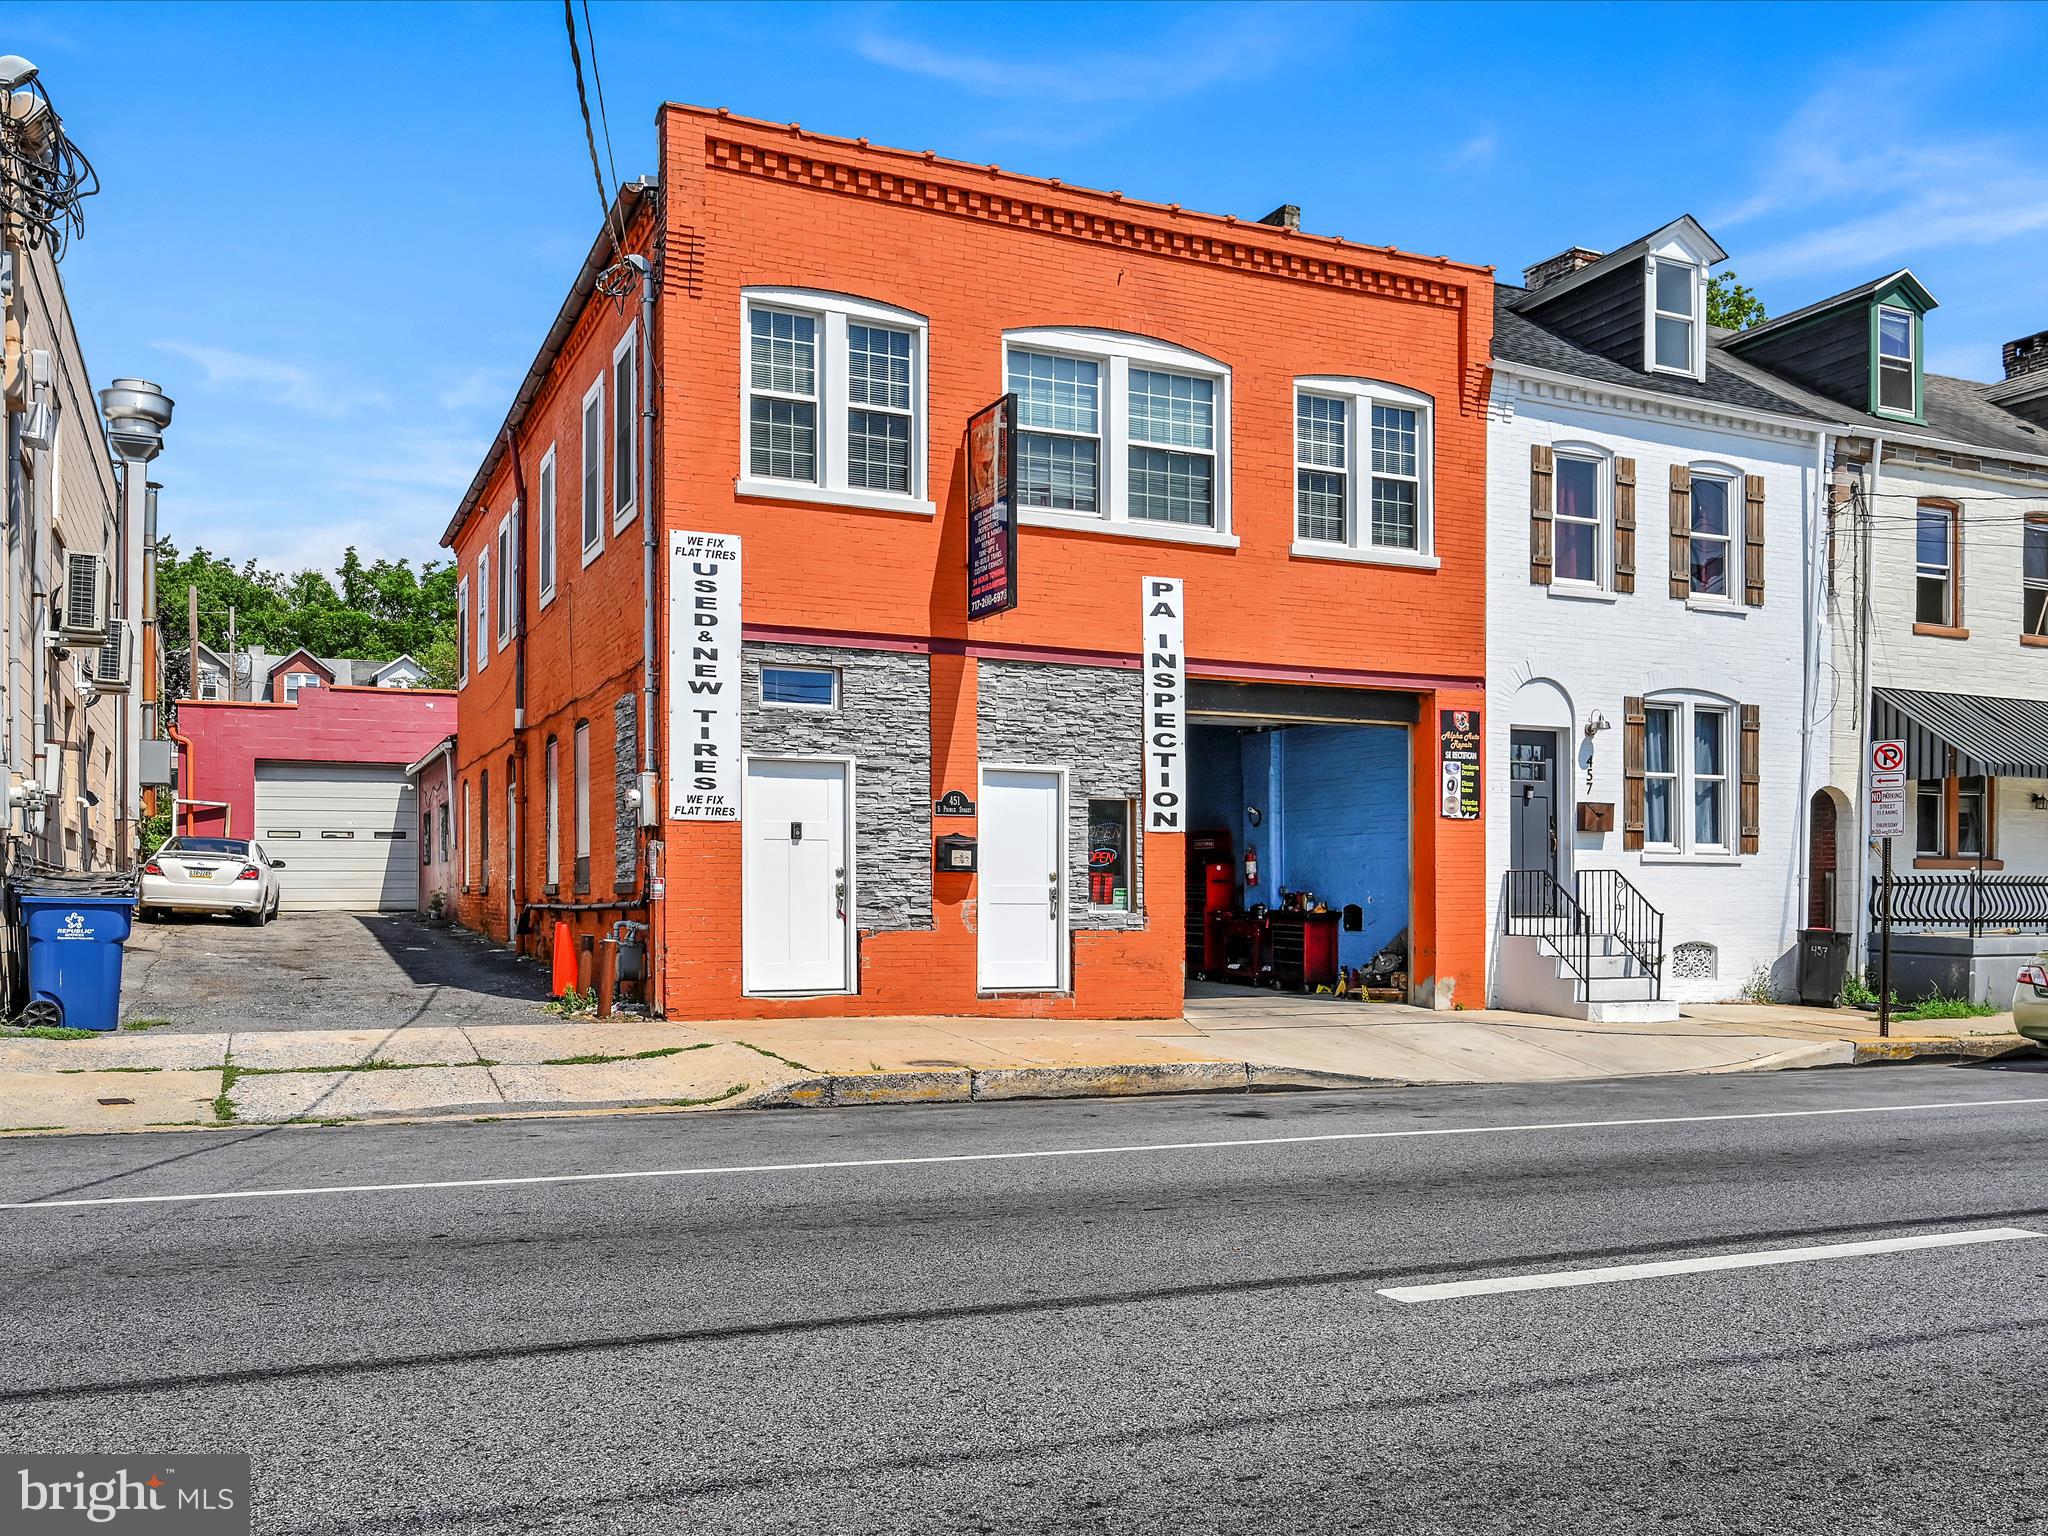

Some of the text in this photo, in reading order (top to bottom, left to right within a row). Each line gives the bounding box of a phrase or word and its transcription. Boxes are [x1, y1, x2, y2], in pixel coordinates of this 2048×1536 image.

[687, 536, 725, 548] WE FIX
[675, 546, 736, 560] FLAT TIRES
[1149, 582, 1178, 827] PA INSPECTION
[693, 709, 718, 790] TIRES
[1450, 740, 1473, 750] Repair
[687, 795, 724, 805] WE FIX
[949, 796, 960, 805] 451
[1872, 791, 1903, 802] NO PARKING
[674, 806, 736, 816] FLAT TIRES
[1811, 945, 1828, 958] 457
